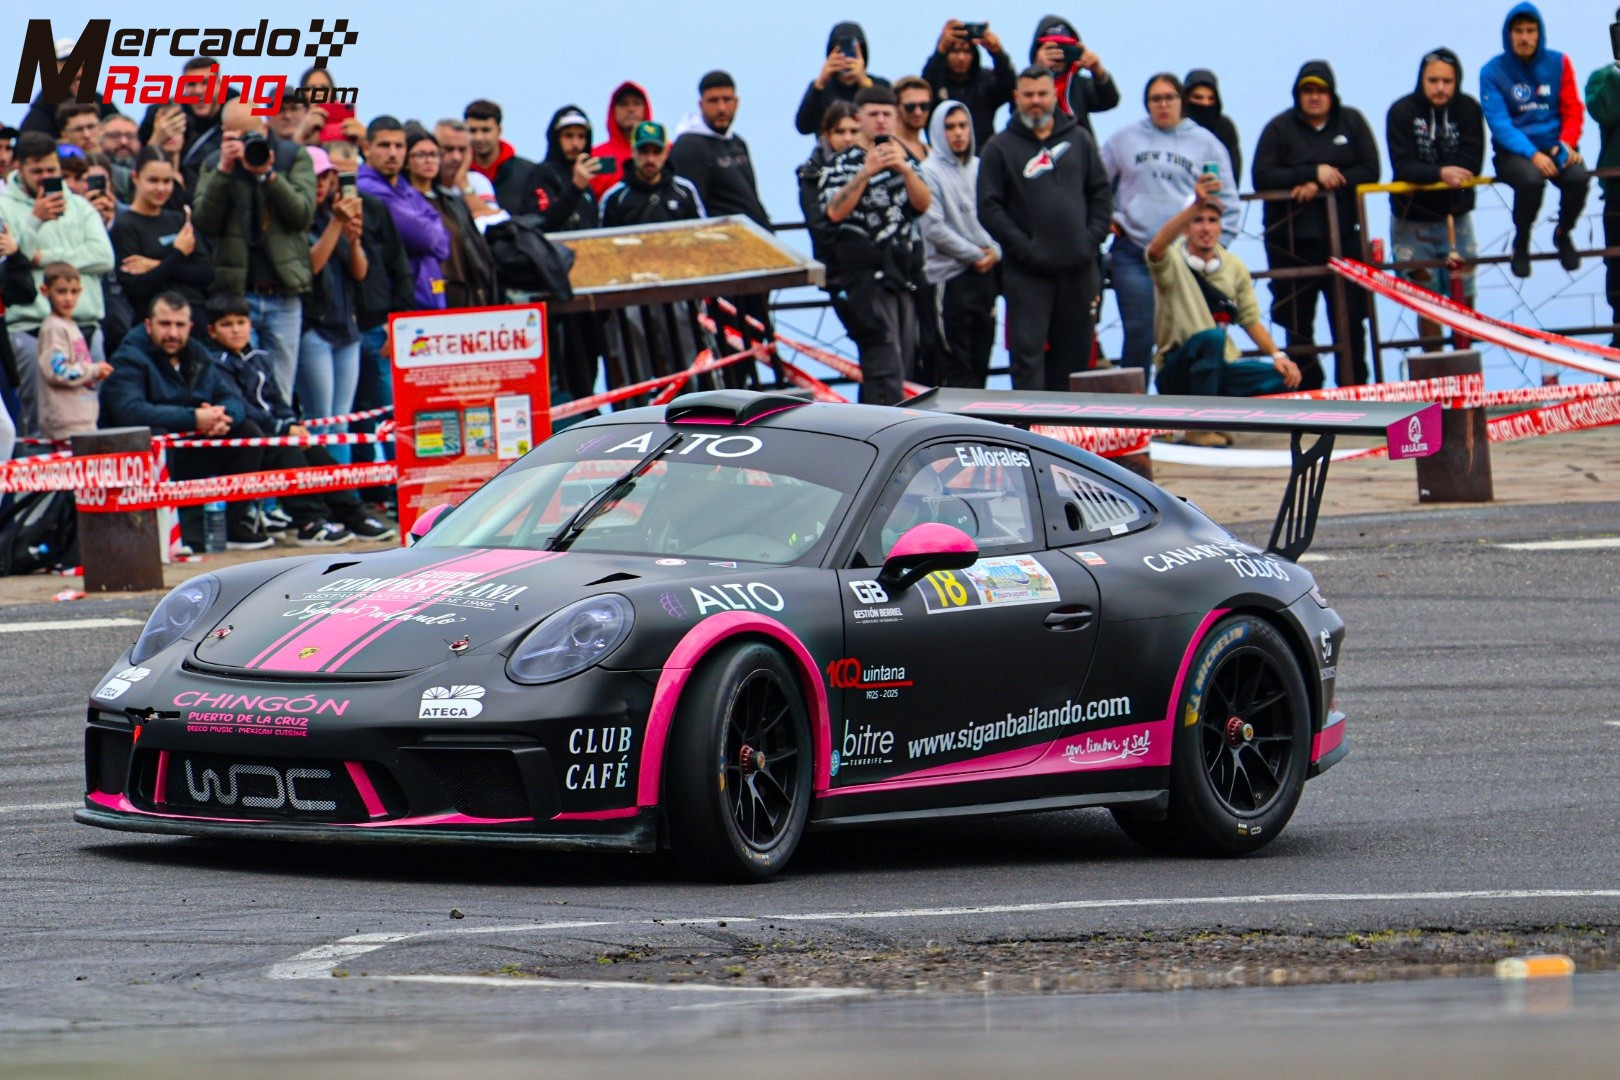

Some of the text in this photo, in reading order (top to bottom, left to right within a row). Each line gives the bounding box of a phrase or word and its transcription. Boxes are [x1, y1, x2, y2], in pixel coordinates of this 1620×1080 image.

[1136, 151, 1161, 165] NEW
[960, 402, 1367, 423] PORSCHE
[954, 446, 1031, 468] E.Morales
[86, 455, 144, 489] PUBLICO
[1143, 541, 1229, 573] CANARY
[1224, 558, 1290, 582] TOLDOS
[690, 582, 784, 615] ALTO
[848, 580, 889, 604] GB
[926, 569, 968, 607] 18
[853, 607, 903, 619] GESTIÓN BERRIEL
[1195, 626, 1244, 691] MICHELIN
[173, 691, 350, 716] CHINGÓN
[866, 690, 879, 699] 1925
[883, 689, 899, 698] 2025
[188, 712, 309, 726] PUERTO DE LA CRUZ
[421, 707, 469, 717] ATECA
[238, 727, 273, 735] MEXICAN
[275, 729, 308, 737] CUISINE
[842, 719, 894, 757] bitre
[907, 696, 1131, 759] www.siganbailando.com
[568, 726, 632, 755] CLUB
[565, 754, 629, 790] CAFÉ
[850, 757, 883, 766] TENERIFE
